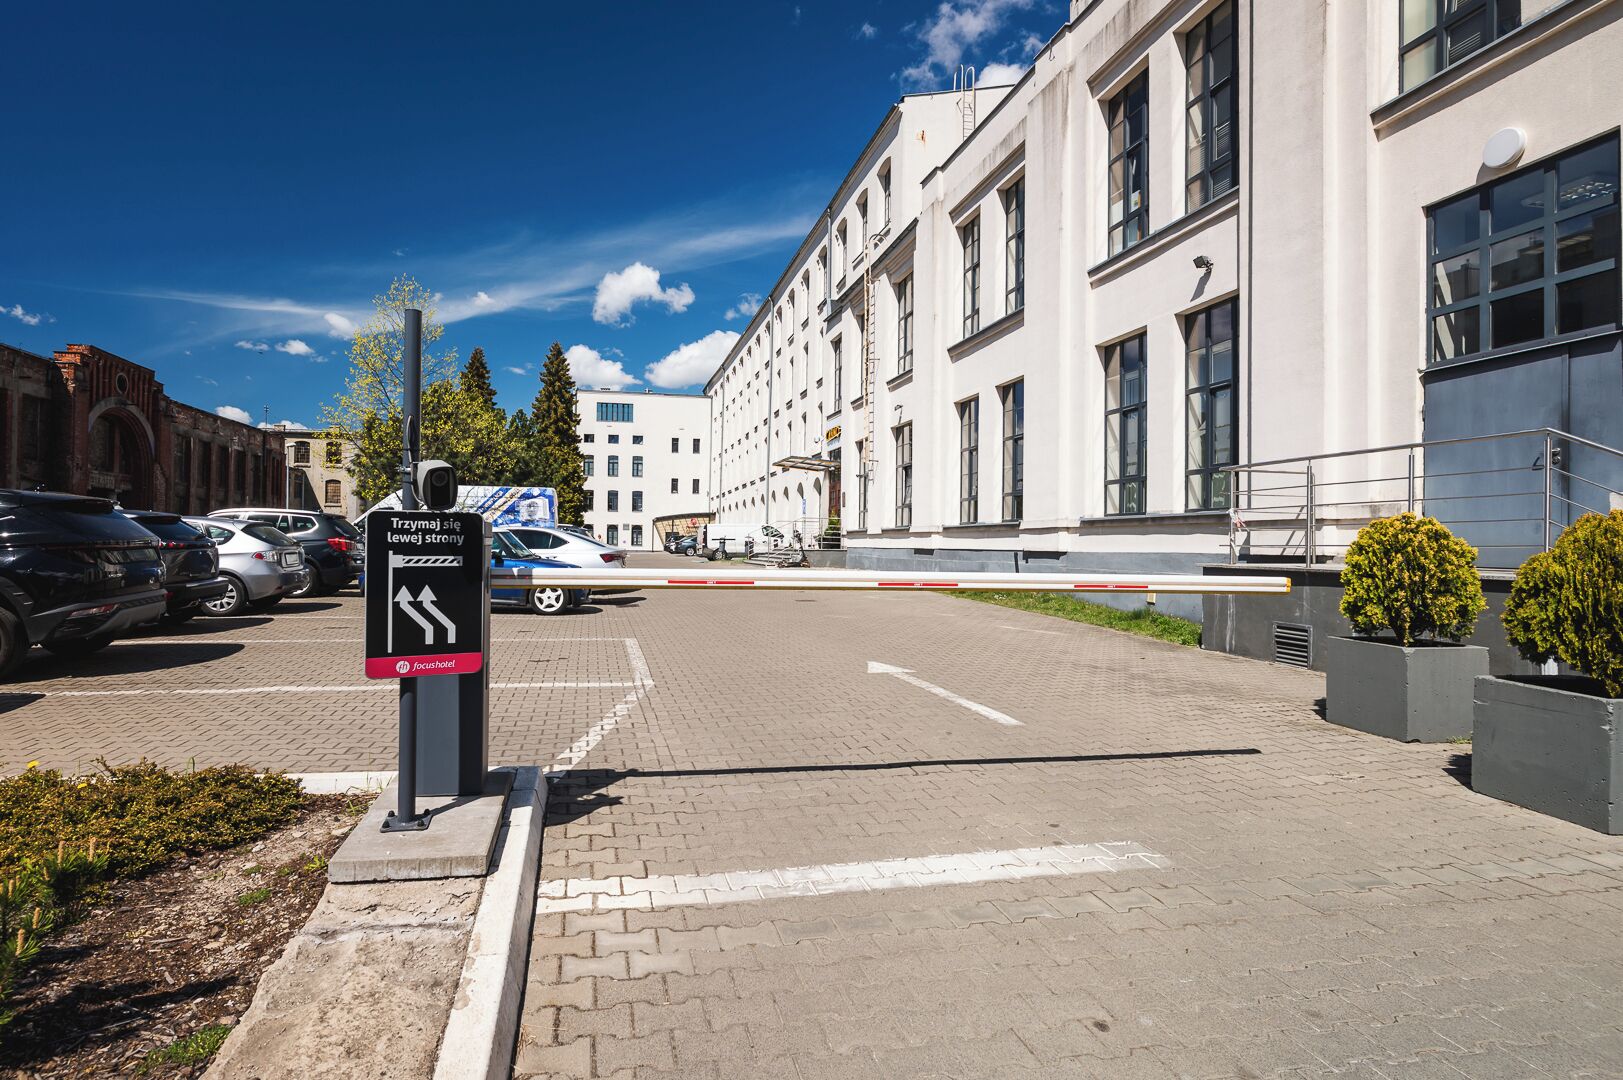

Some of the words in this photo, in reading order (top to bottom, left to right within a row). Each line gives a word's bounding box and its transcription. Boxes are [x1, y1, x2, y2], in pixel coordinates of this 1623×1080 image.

[391, 517, 440, 531] Trzymaj
[443, 518, 461, 531] się
[387, 531, 422, 545] lewej
[425, 533, 464, 546] strony
